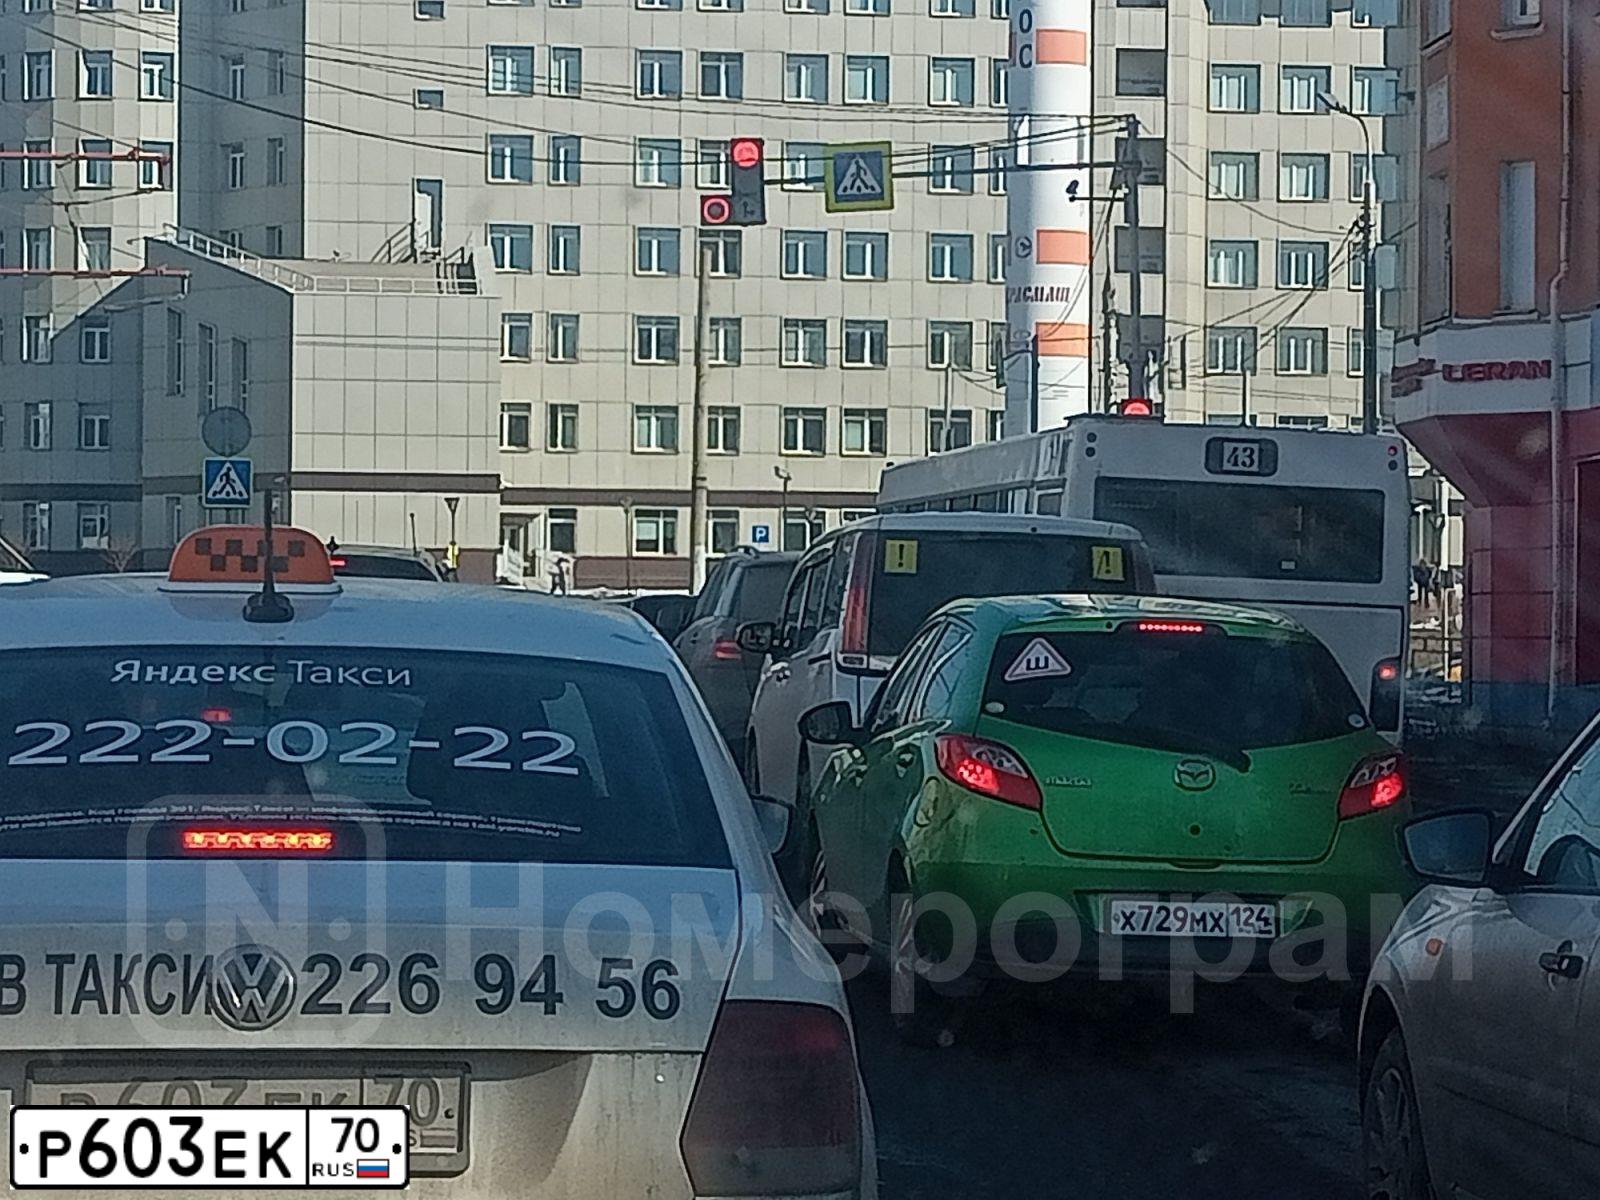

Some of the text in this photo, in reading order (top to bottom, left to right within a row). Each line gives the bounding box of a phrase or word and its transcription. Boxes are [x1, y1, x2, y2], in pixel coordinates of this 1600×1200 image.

[1226, 446, 1255, 468] 43
[110, 659, 411, 686] Яндекс Такси
[7, 719, 580, 776] 222-02-22
[46, 952, 213, 1017] ТАКСИ
[299, 952, 441, 1015] 226
[474, 953, 564, 1016] 94
[596, 957, 681, 1020] 56
